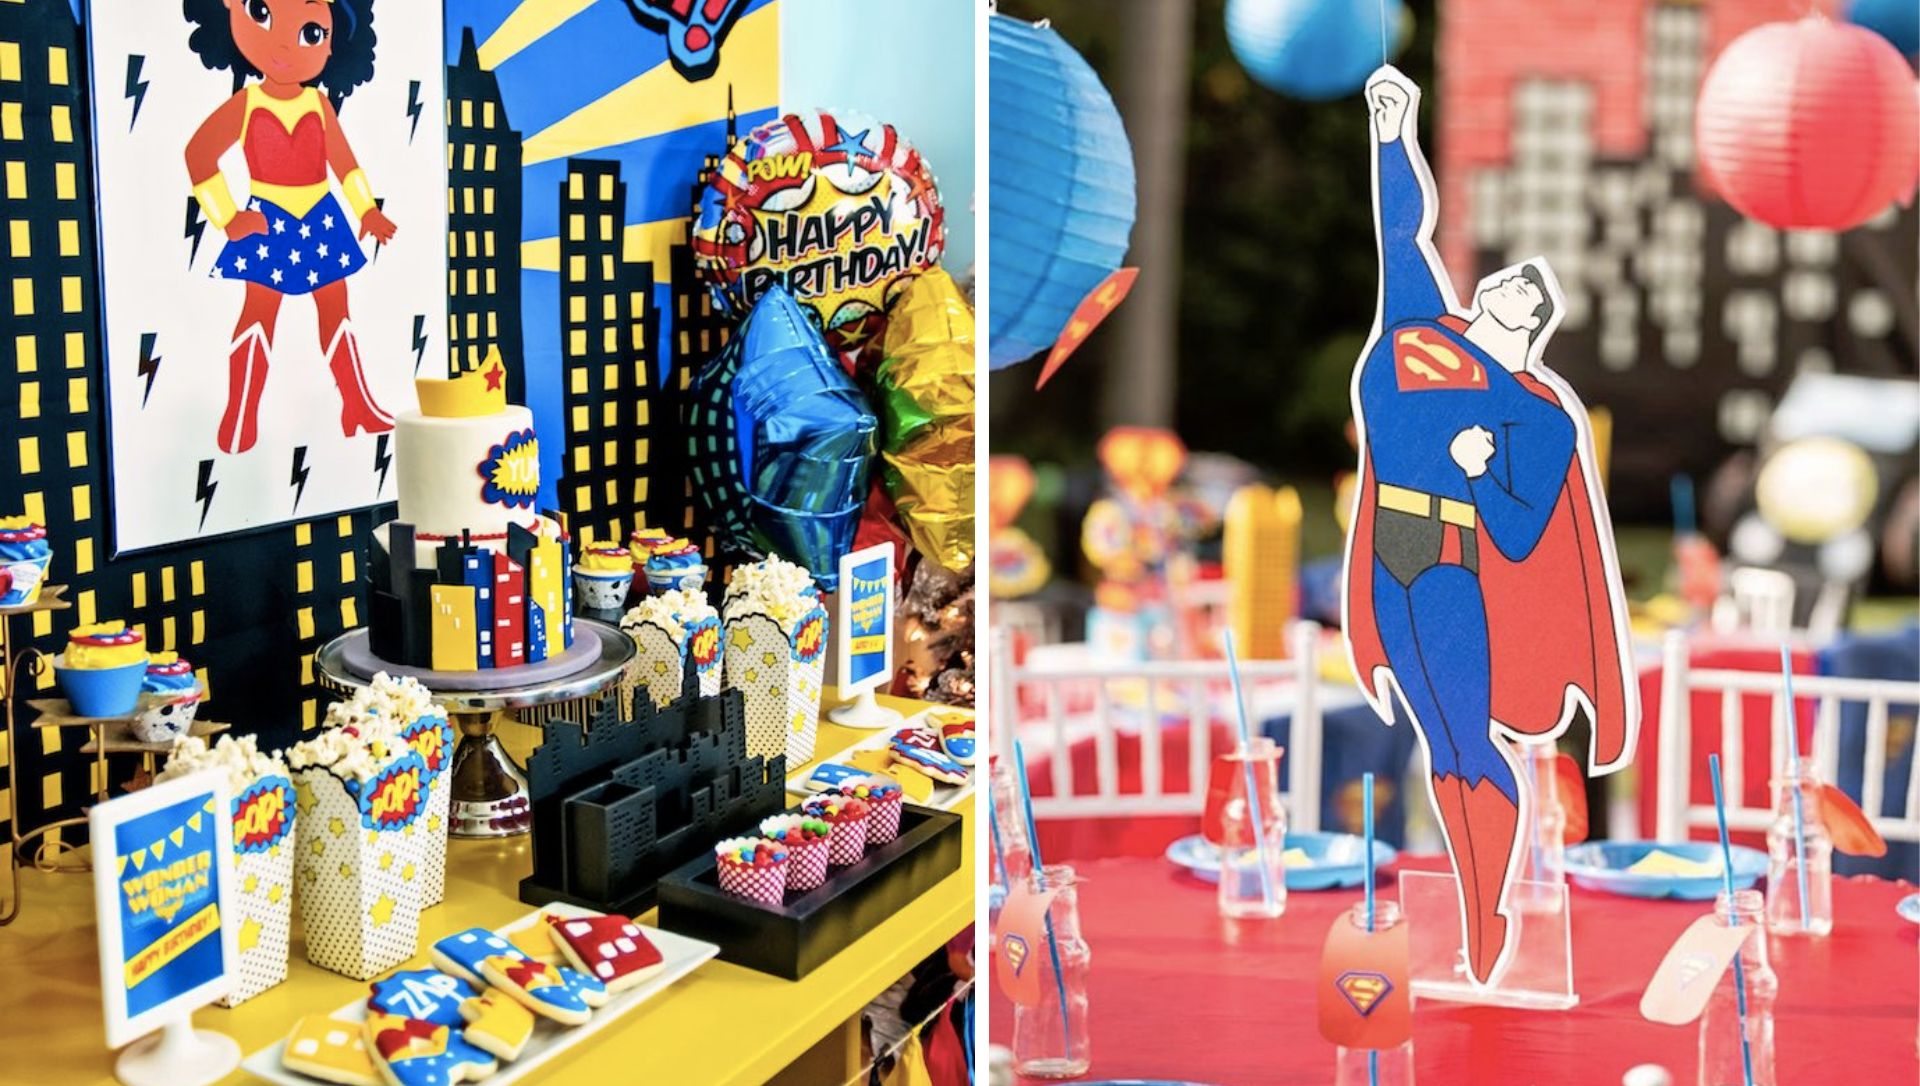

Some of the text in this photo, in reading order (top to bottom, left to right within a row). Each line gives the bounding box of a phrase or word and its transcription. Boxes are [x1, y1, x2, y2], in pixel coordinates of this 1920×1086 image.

[749, 152, 812, 182] POW!
[766, 191, 897, 262] HAPPY
[692, 624, 719, 659] OP!
[233, 786, 285, 845] POP!
[371, 767, 420, 824] POP!
[387, 973, 465, 1020] ZAP
